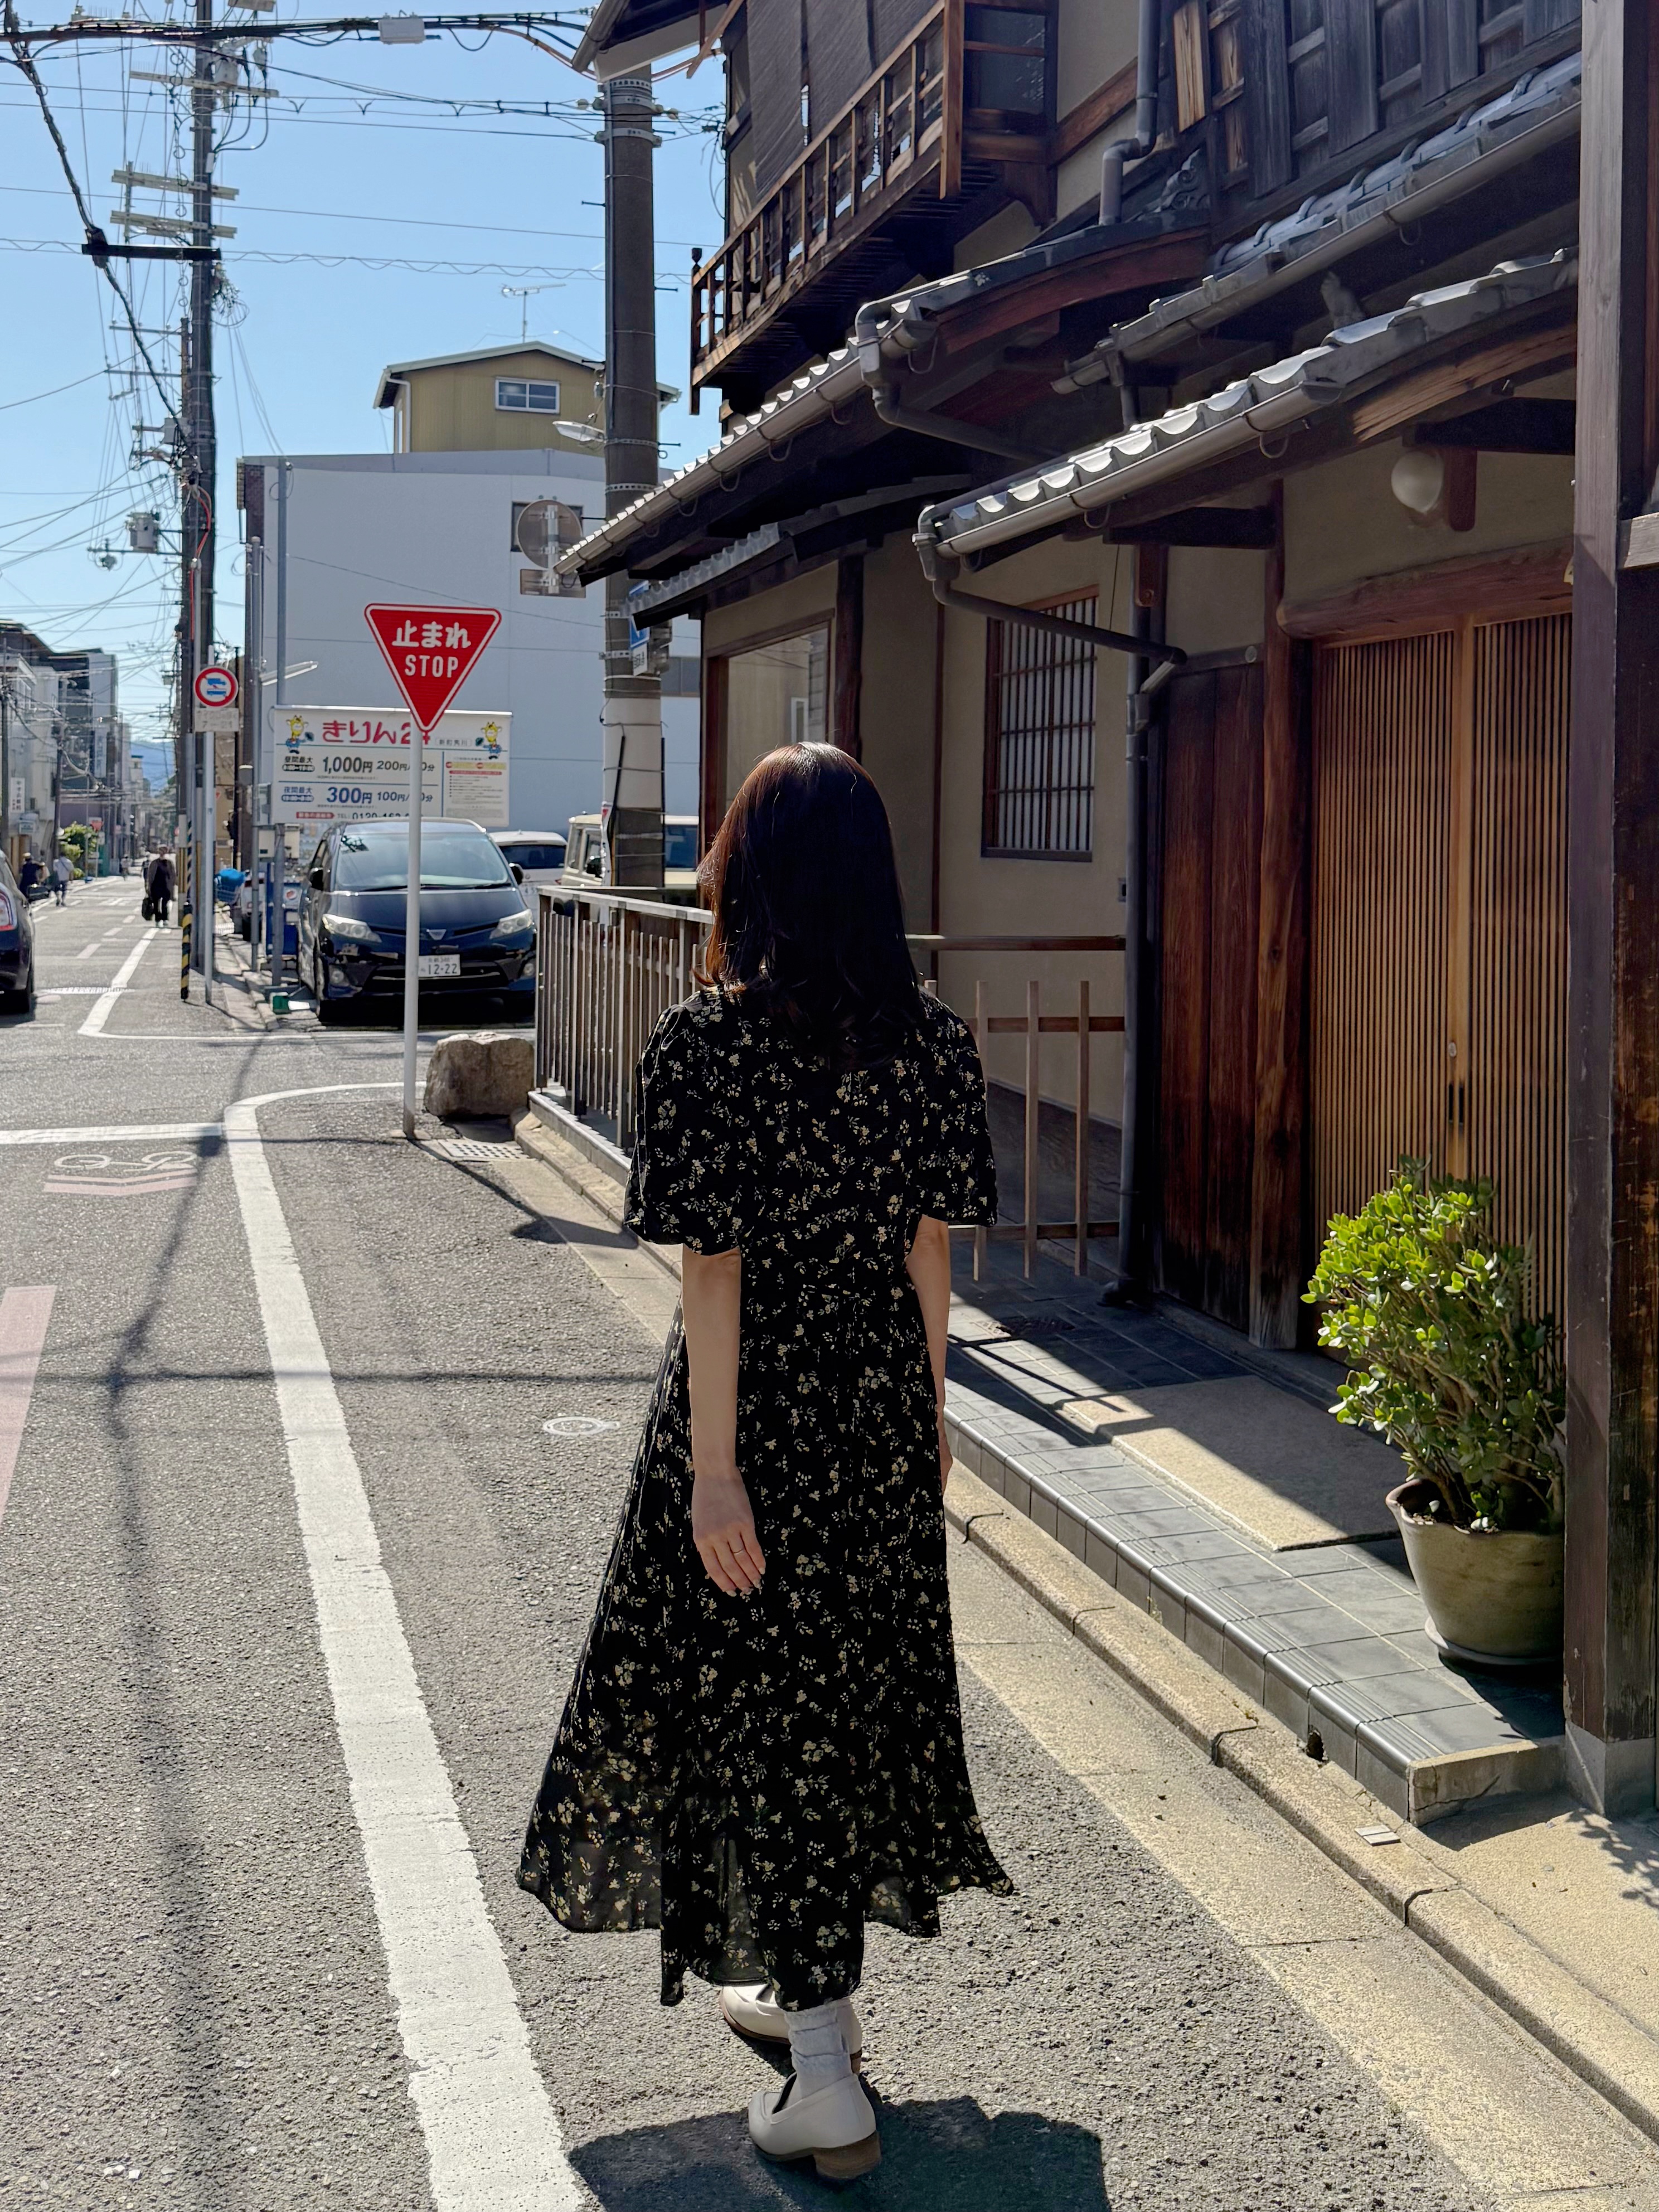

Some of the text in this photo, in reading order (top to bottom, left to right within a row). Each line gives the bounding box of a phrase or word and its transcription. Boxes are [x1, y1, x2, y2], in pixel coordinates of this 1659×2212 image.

[391, 619, 472, 649] 止まれ
[405, 654, 459, 678] STOP
[322, 720, 430, 745] きりん2
[323, 756, 373, 774] 1,000円
[326, 787, 372, 804] 300円
